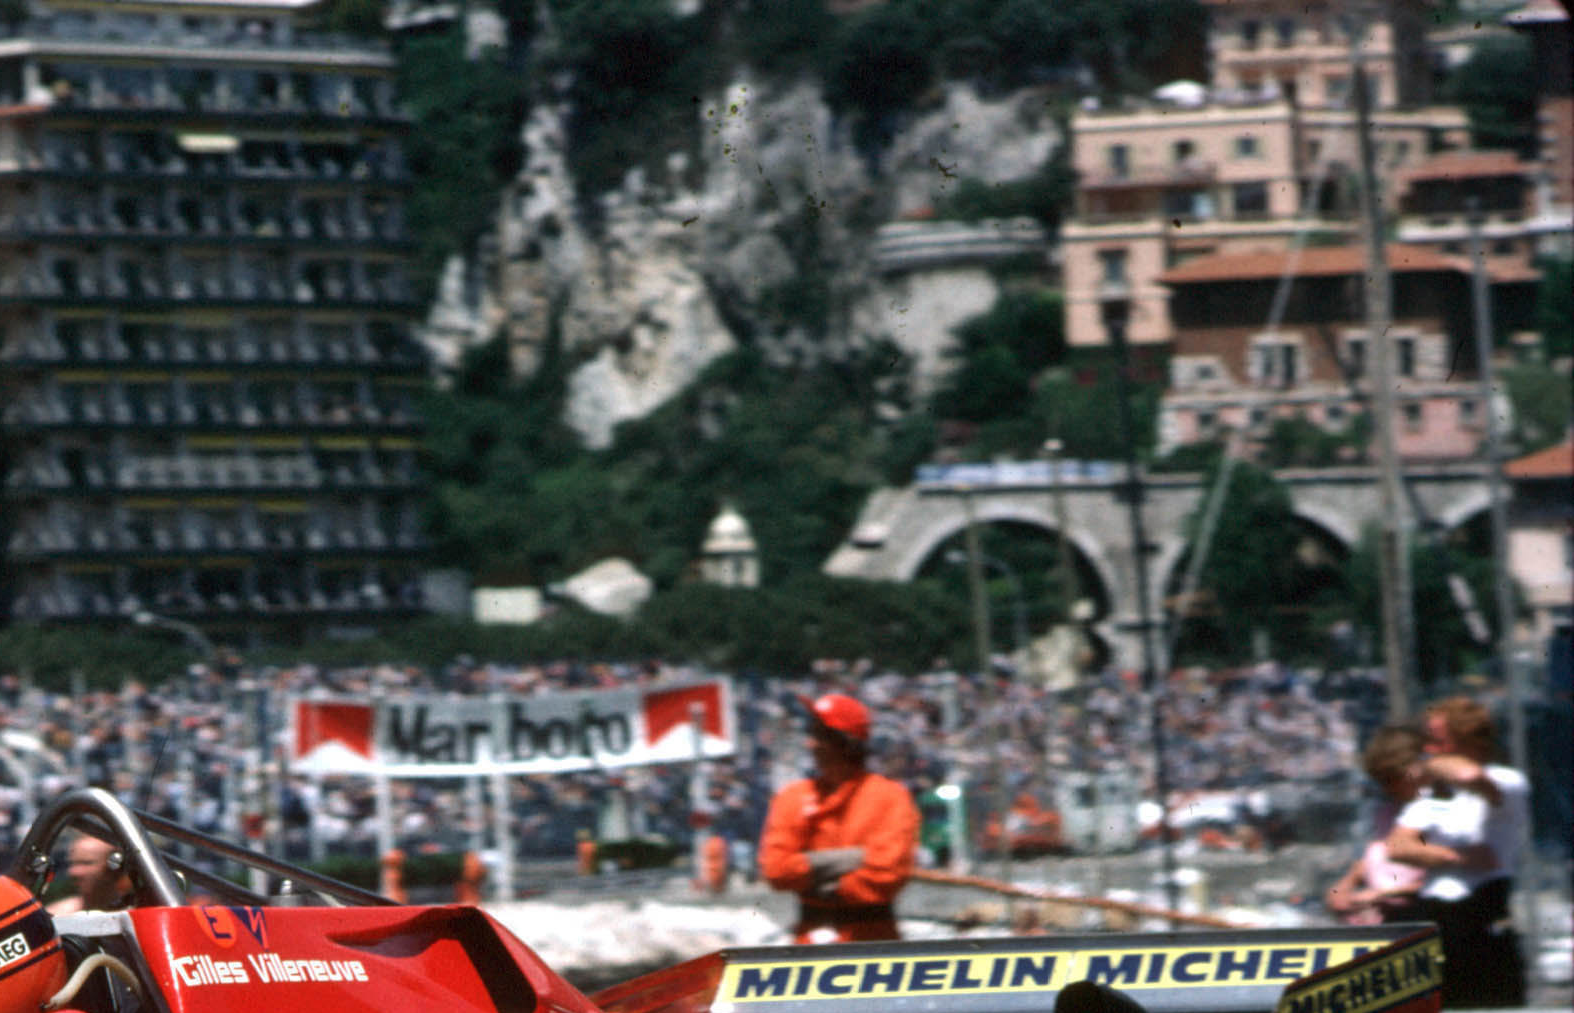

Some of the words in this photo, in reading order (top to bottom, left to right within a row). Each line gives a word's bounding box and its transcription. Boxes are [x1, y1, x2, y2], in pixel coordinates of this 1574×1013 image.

[389, 701, 630, 763] Marboro
[175, 954, 250, 987] Gilles
[247, 953, 370, 984] Villeneuve
[734, 955, 1058, 999] MICHELIN
[1085, 944, 1376, 985] MICHEL
